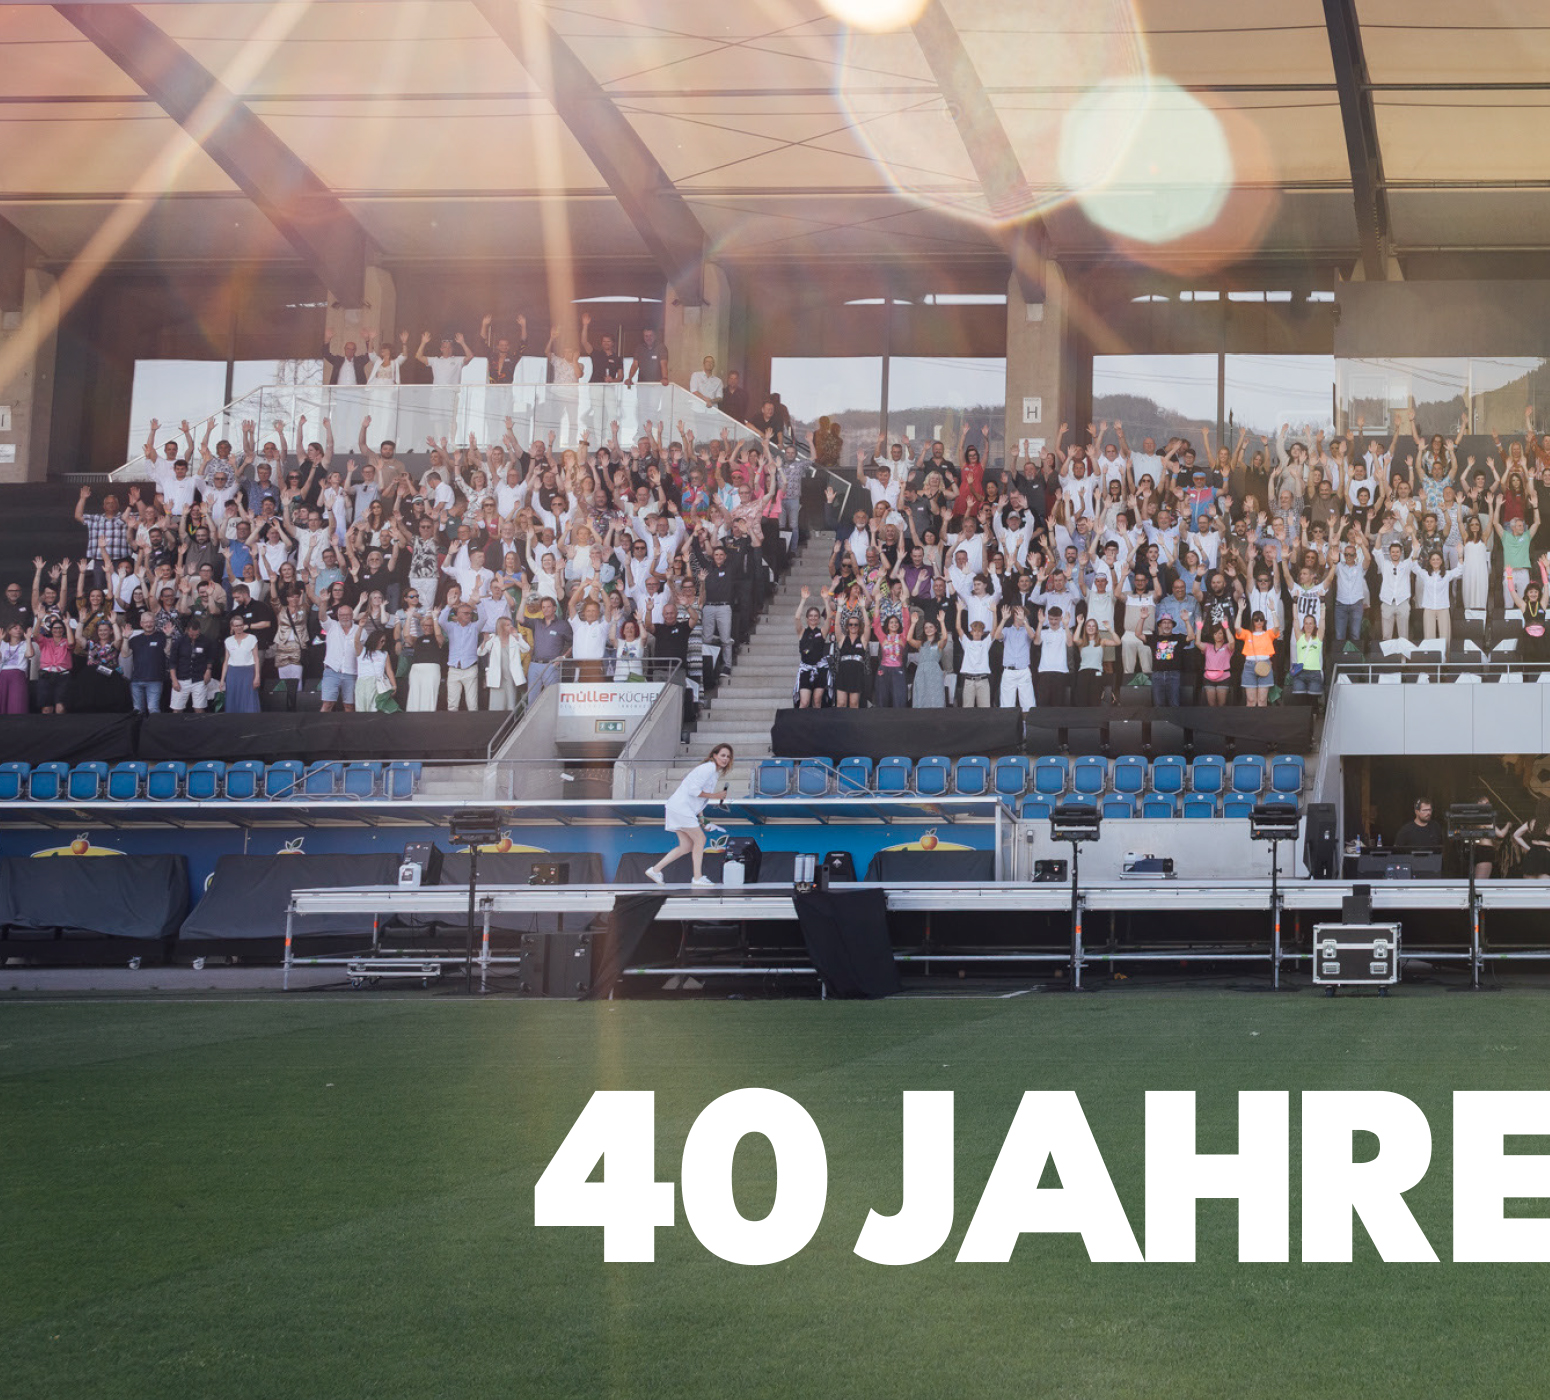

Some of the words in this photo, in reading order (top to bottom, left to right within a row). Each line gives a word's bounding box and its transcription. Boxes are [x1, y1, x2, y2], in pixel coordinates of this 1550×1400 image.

[1026, 406, 1038, 419] H
[1298, 596, 1318, 615] LIFE
[560, 691, 617, 703] müller
